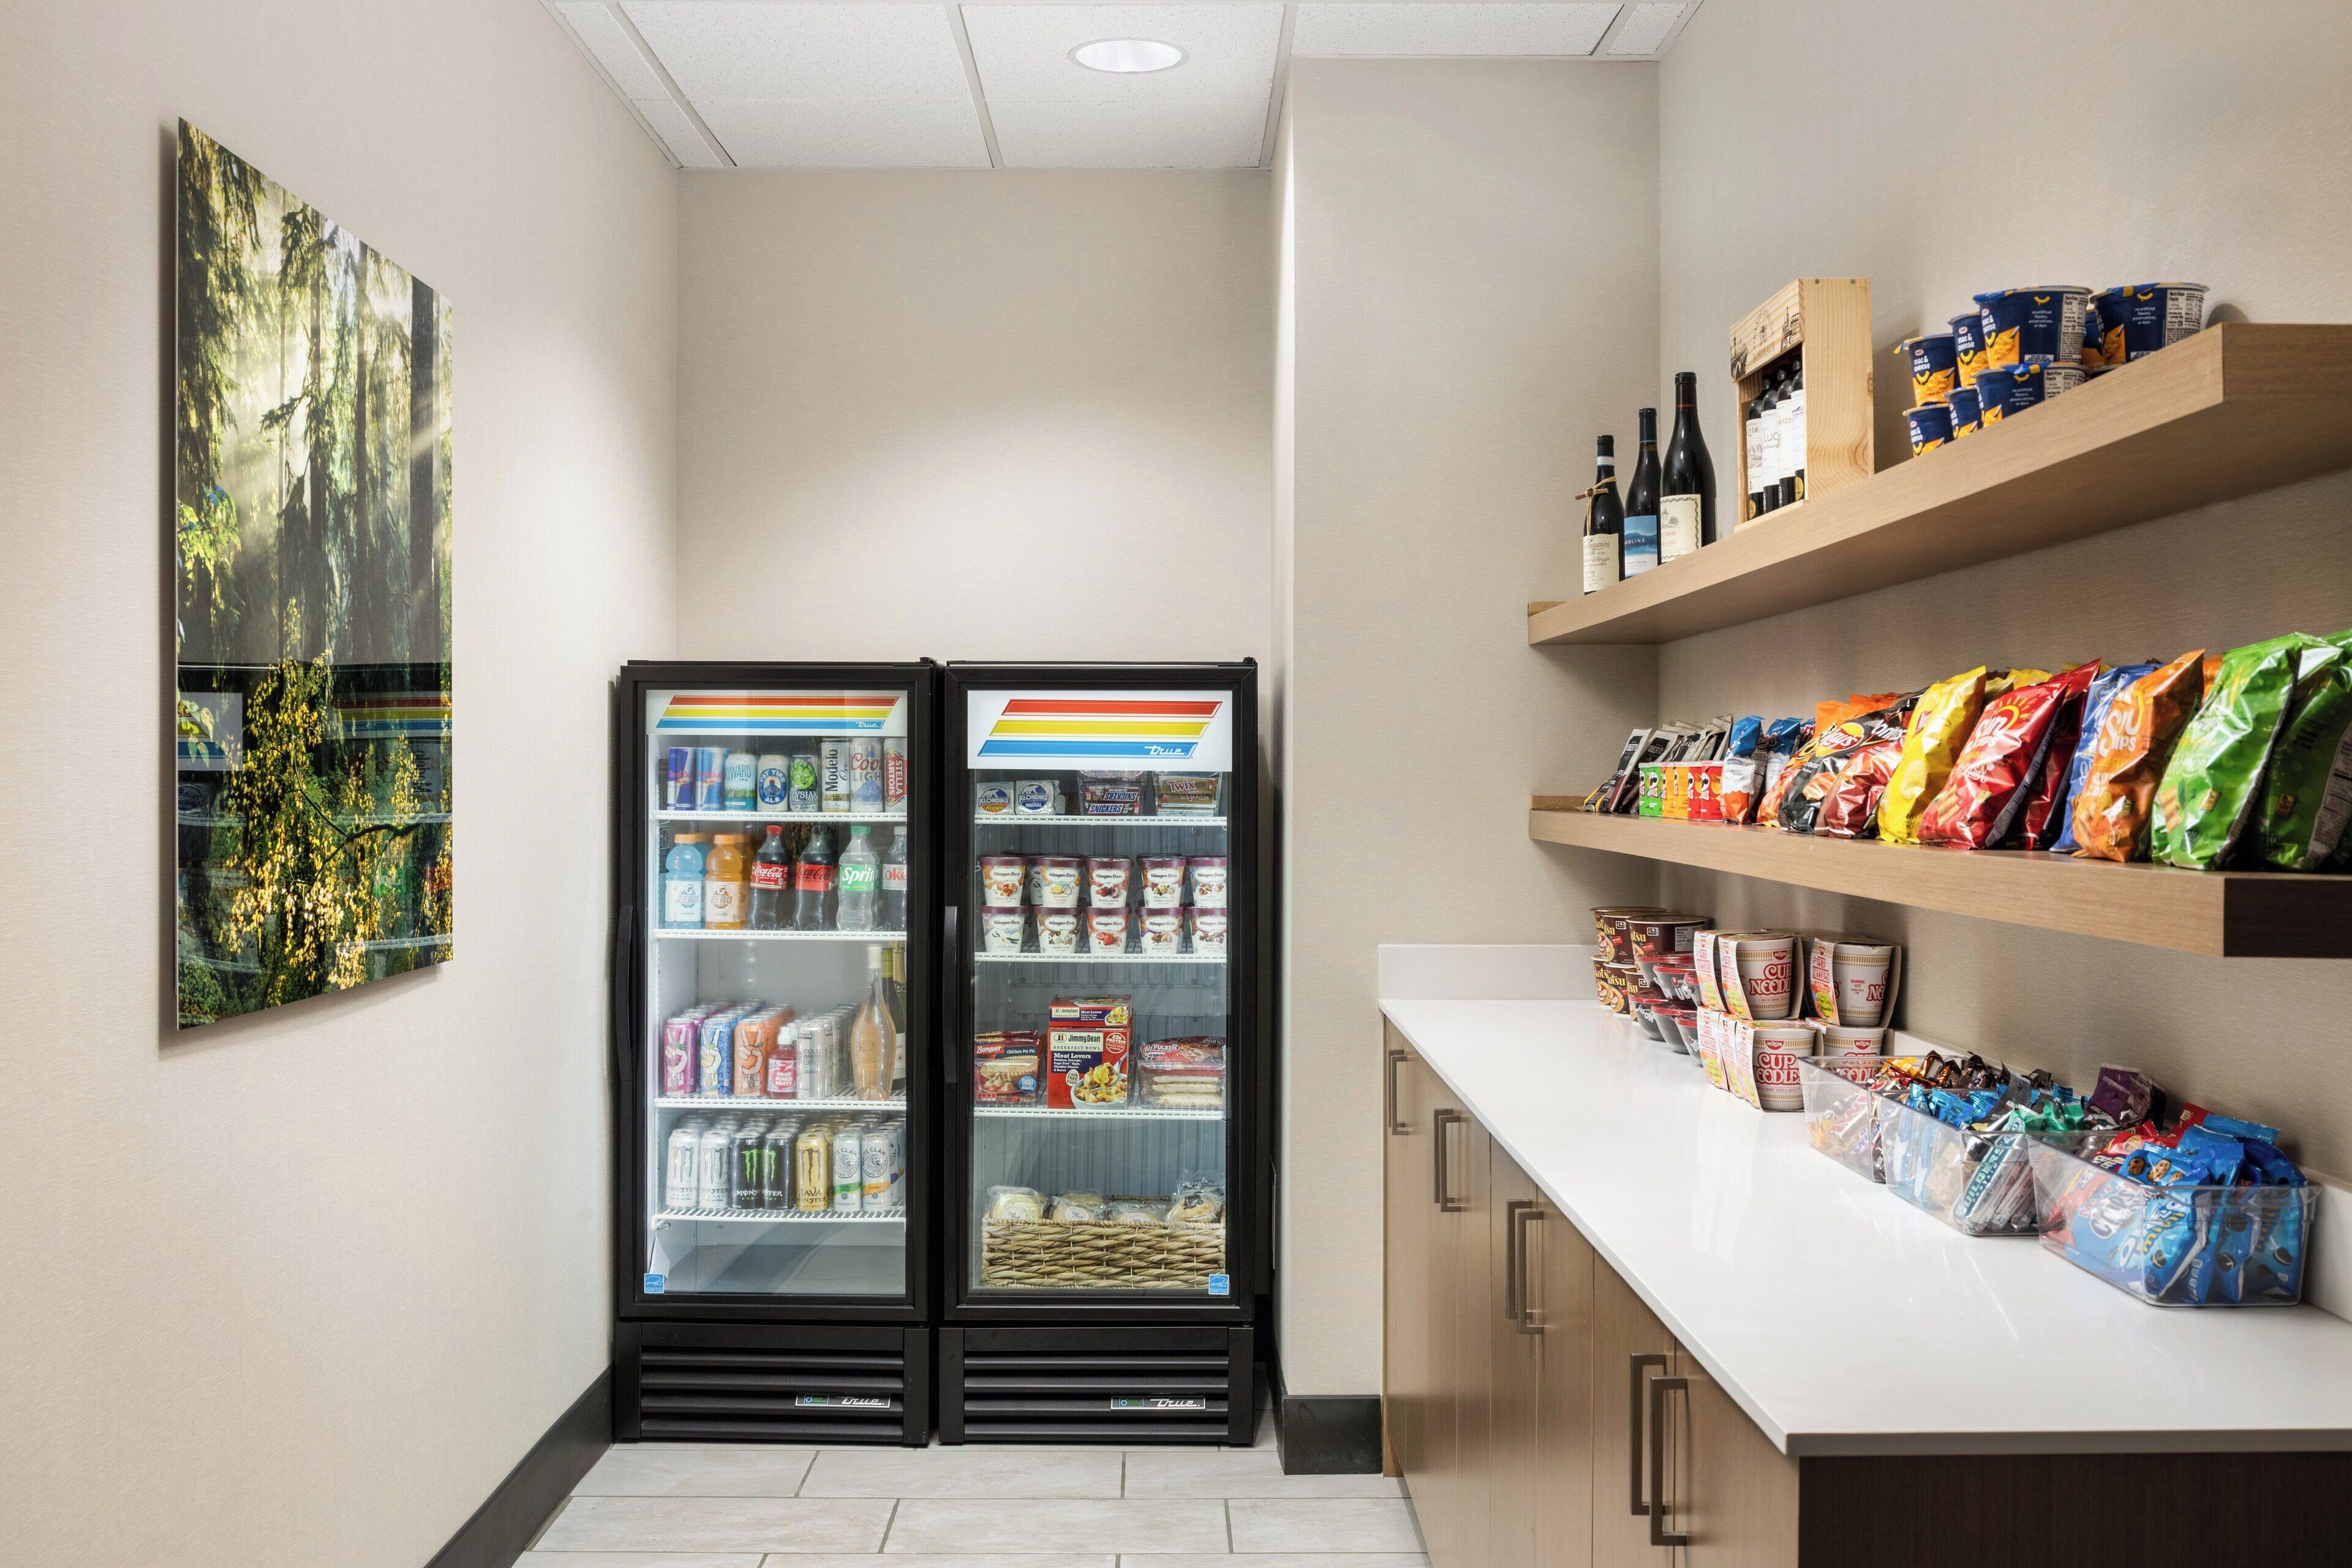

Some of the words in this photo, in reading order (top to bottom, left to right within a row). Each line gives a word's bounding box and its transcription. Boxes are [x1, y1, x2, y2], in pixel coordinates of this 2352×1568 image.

[1647, 745, 1664, 755] OBERTO
[825, 748, 838, 792] Modelo
[760, 770, 769, 783] FAT
[771, 769, 786, 783] TIRE
[1167, 780, 1196, 793] Twix
[1019, 793, 1049, 804] KLONDIKE
[1104, 792, 1137, 801] SNICKERS
[979, 797, 1010, 807] KLONDIKE
[1090, 804, 1123, 813] SNICKERS
[755, 865, 784, 878] Coca-Cola
[677, 895, 698, 903] ZERO
[711, 895, 733, 904] ZERO
[1763, 962, 1791, 980] CUP
[1068, 1035, 1087, 1043] Jimmy
[1757, 1052, 1796, 1069] CUP
[744, 1073, 759, 1082] PEACE
[841, 1147, 858, 1157] CLAW
[869, 1147, 886, 1156] CLAW
